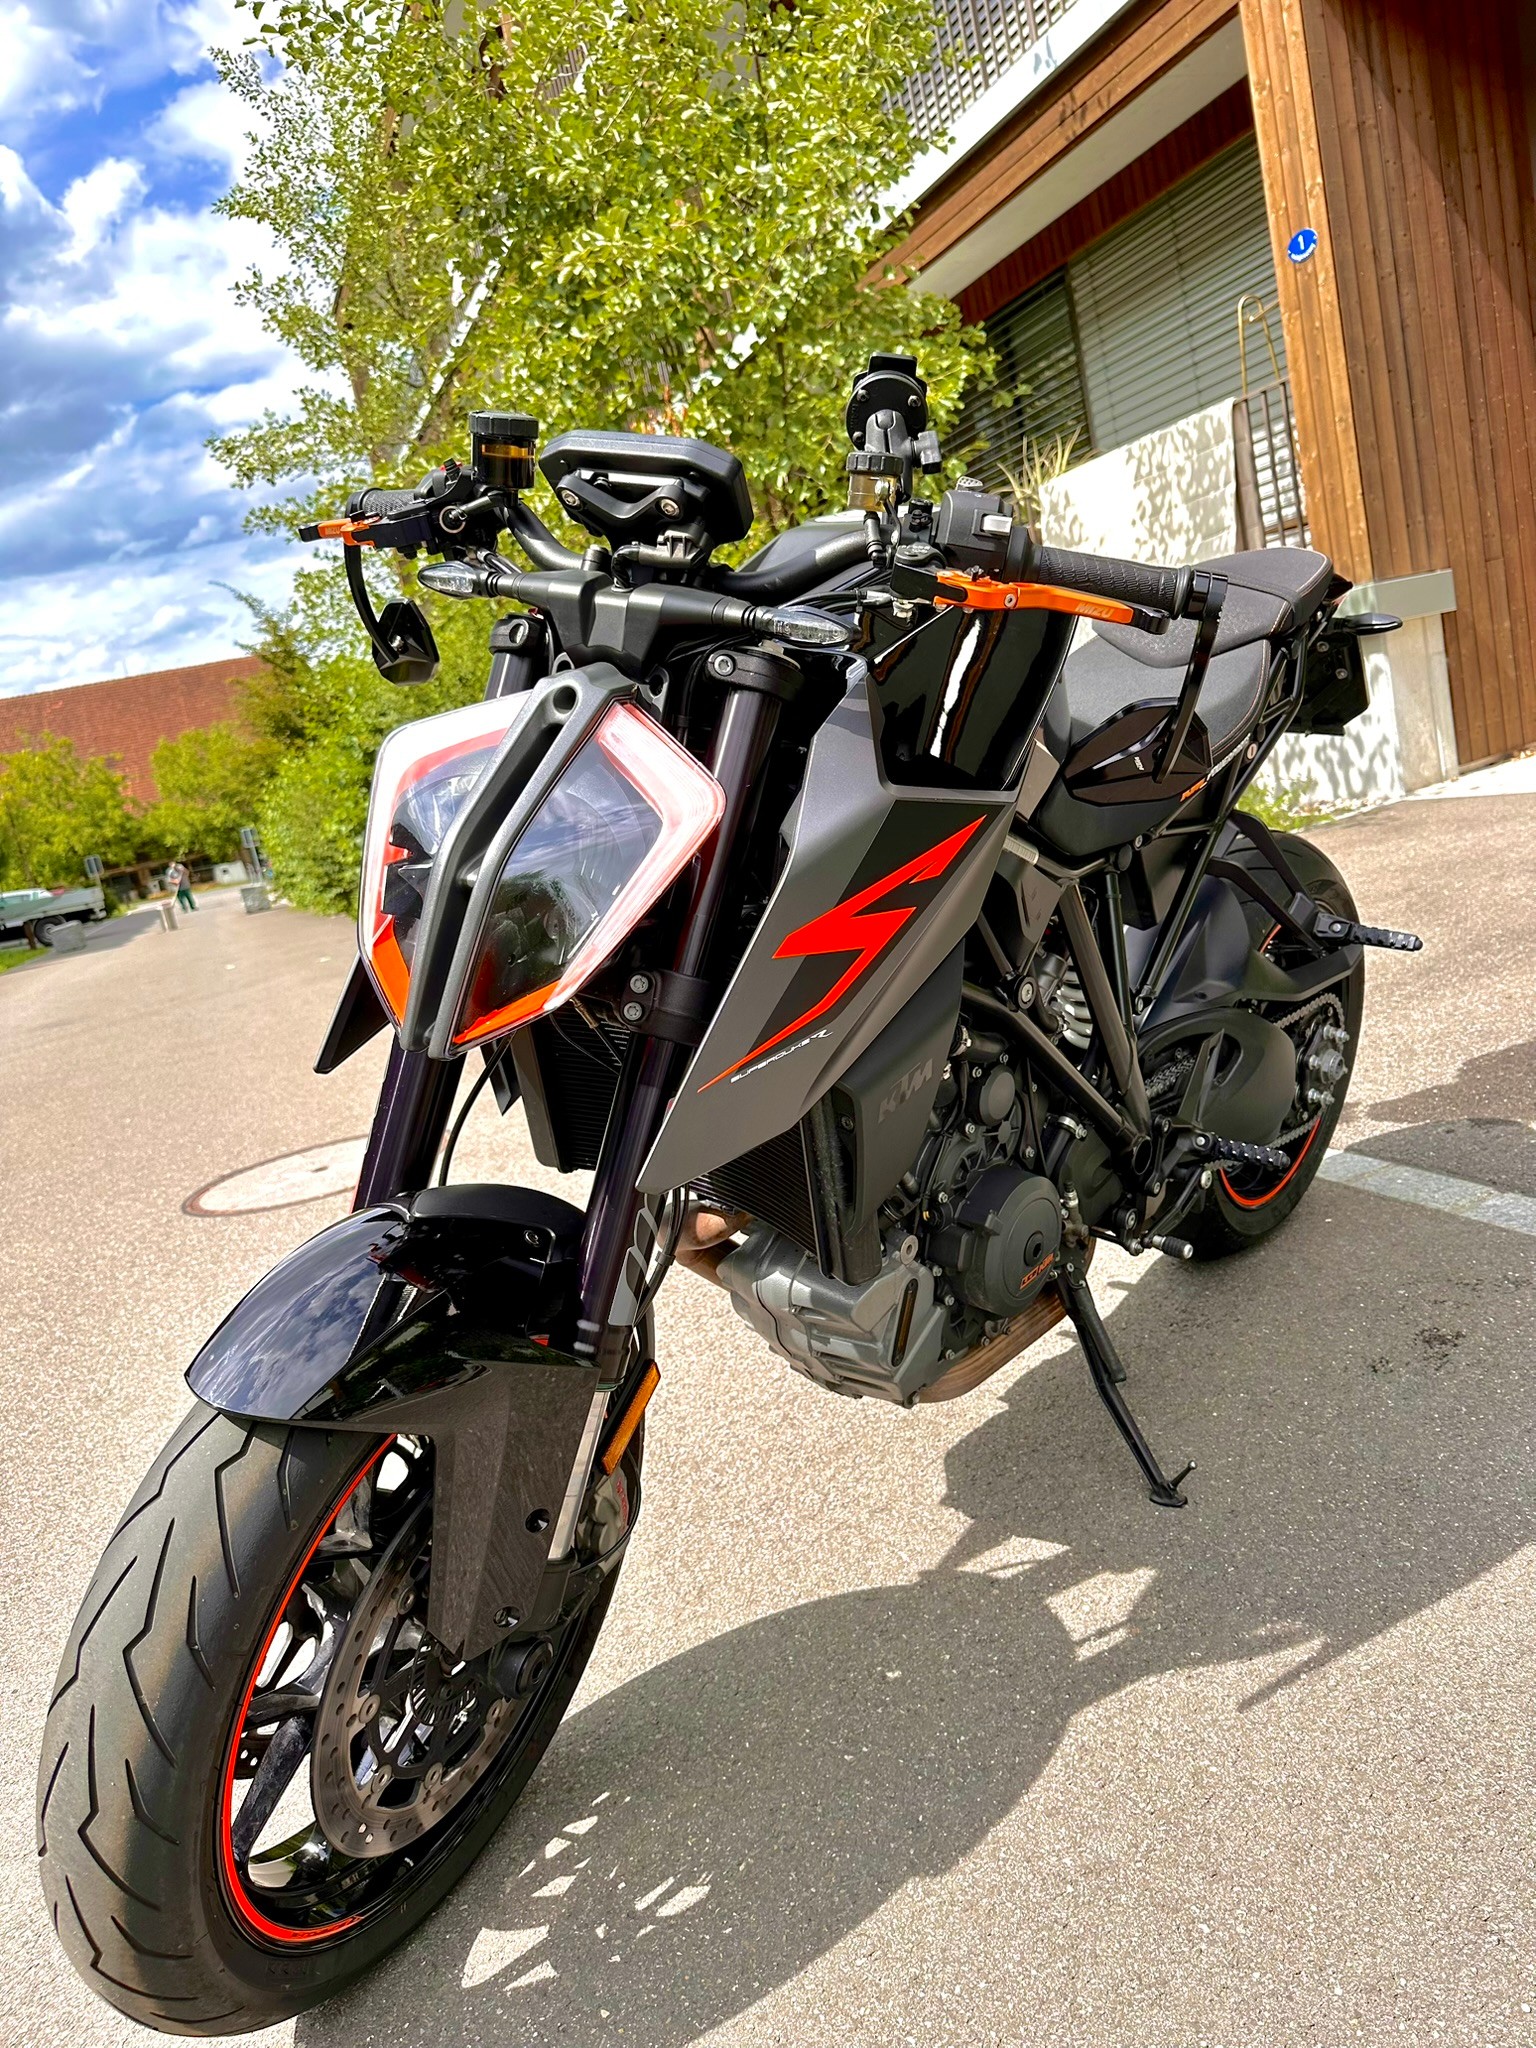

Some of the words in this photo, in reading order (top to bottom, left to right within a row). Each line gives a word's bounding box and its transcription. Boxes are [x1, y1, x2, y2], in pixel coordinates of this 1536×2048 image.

[1297, 234, 1305, 250] 1
[1074, 601, 1115, 619] MIZU
[878, 1058, 933, 1125] KTM
